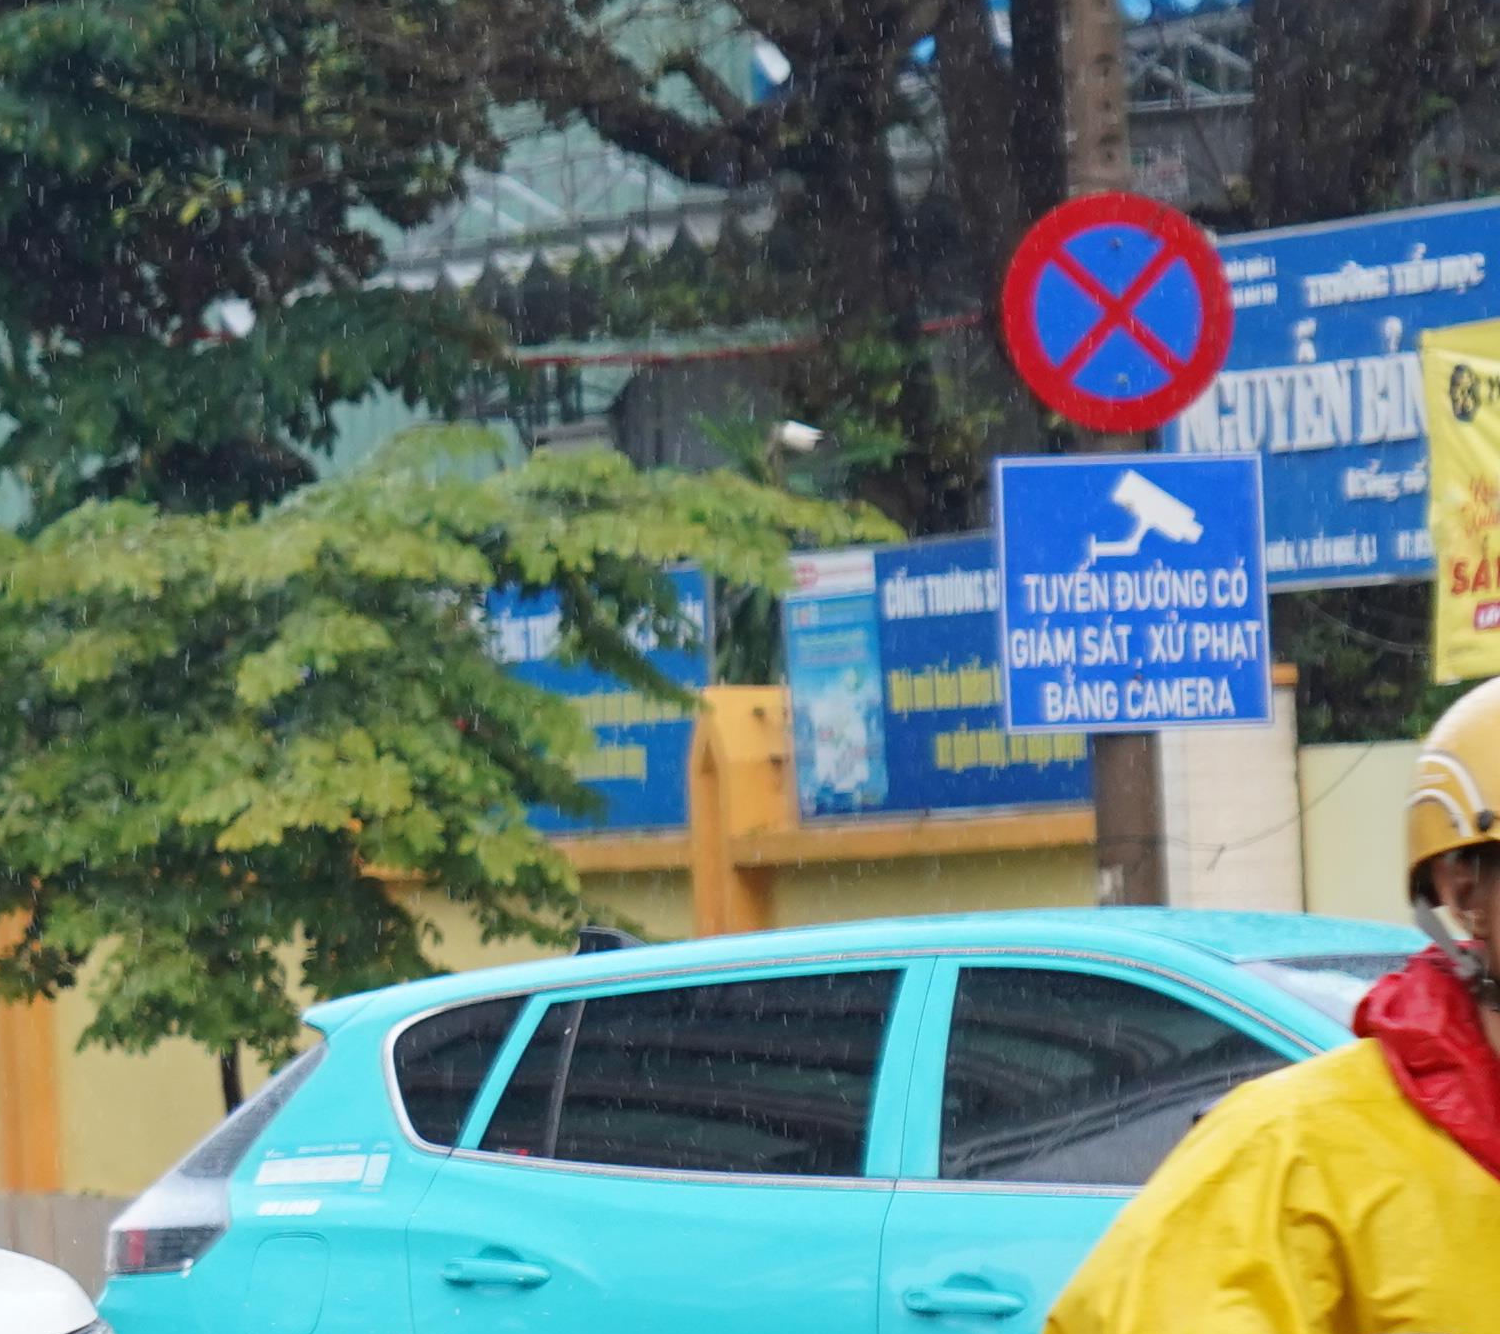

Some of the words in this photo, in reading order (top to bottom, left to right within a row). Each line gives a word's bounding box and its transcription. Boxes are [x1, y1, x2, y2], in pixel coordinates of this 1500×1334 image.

[1023, 558, 1110, 614] TUYẾN
[1114, 558, 1209, 612] ĐƯỜNG
[1213, 555, 1249, 609] CÓ
[1010, 616, 1077, 669] GIÁM
[1150, 610, 1188, 663] XỬ
[1192, 619, 1262, 670] PHẠT
[1044, 665, 1120, 721] BẰNG
[1124, 675, 1236, 718] CAMERA
